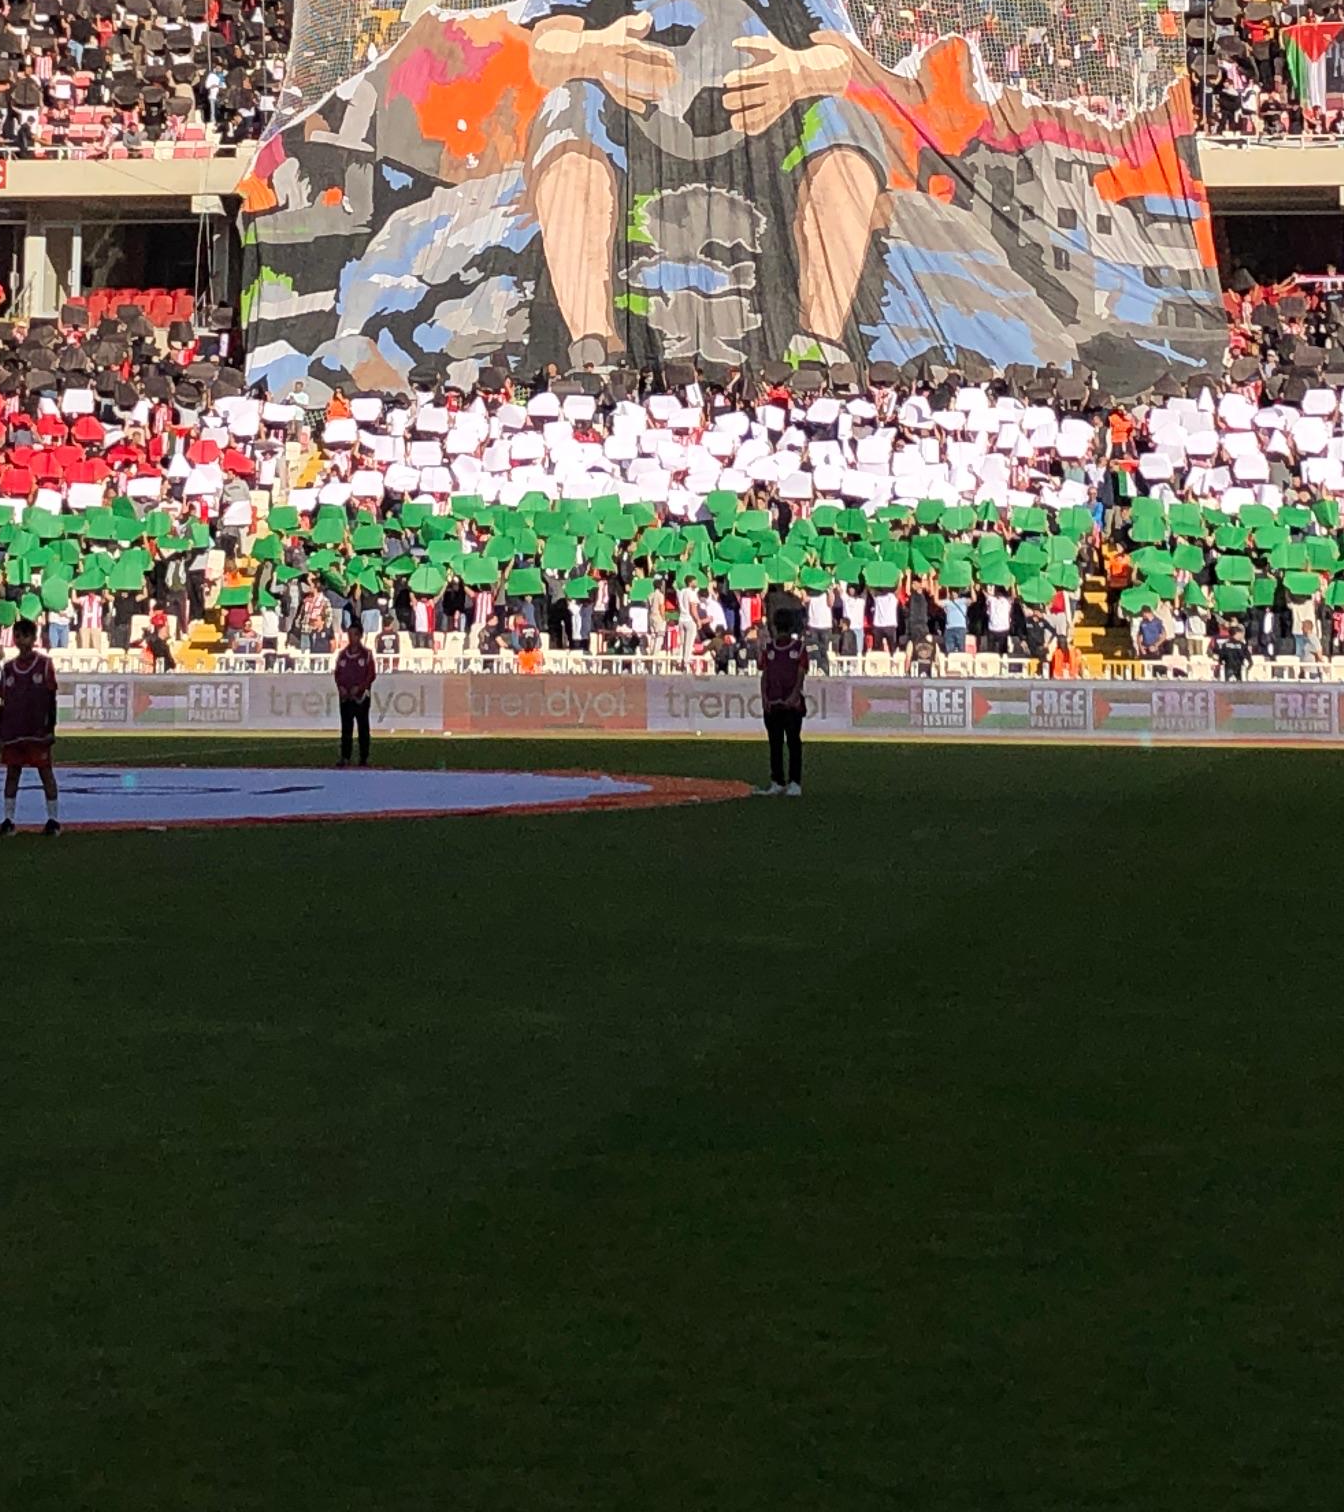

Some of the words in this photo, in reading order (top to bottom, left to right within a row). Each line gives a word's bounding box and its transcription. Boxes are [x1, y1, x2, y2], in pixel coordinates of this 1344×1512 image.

[75, 684, 128, 707] FREE
[187, 685, 241, 708] FREE
[269, 685, 426, 722] trenyol
[466, 685, 628, 722] trendyol
[1030, 690, 1086, 715] FREE
[1152, 691, 1207, 716] FREE
[1274, 693, 1330, 718] FREE
